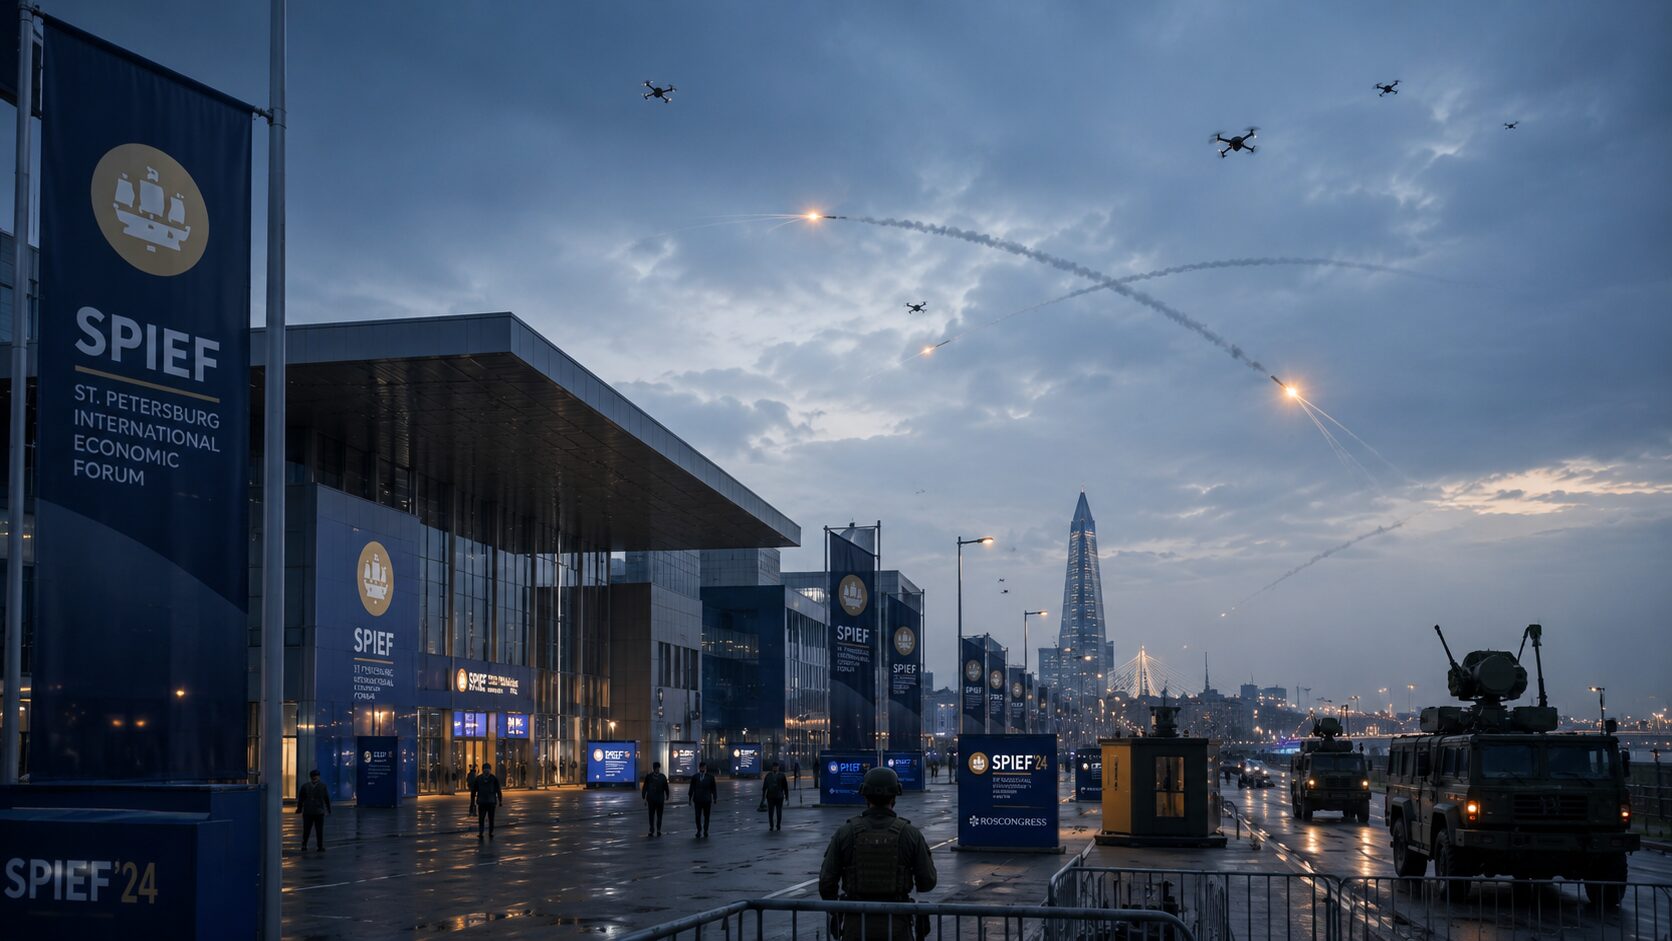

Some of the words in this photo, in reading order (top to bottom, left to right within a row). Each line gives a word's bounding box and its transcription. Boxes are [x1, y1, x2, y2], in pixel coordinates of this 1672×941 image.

[74, 305, 220, 382] SPIEF
[74, 384, 100, 404] ST.
[106, 391, 220, 429] PETERSBURG
[74, 409, 220, 453] INTERNATIONAL
[73, 434, 180, 468] ECONOMIC
[73, 459, 145, 487] FORUM
[353, 627, 394, 657] SPIEF
[836, 625, 870, 644] SPIEF
[892, 663, 917, 674] SPIEF
[992, 754, 1048, 771] SPIEF'24
[980, 816, 1047, 827] ROSCONGRESS
[4, 857, 158, 905] SPIEF'24
